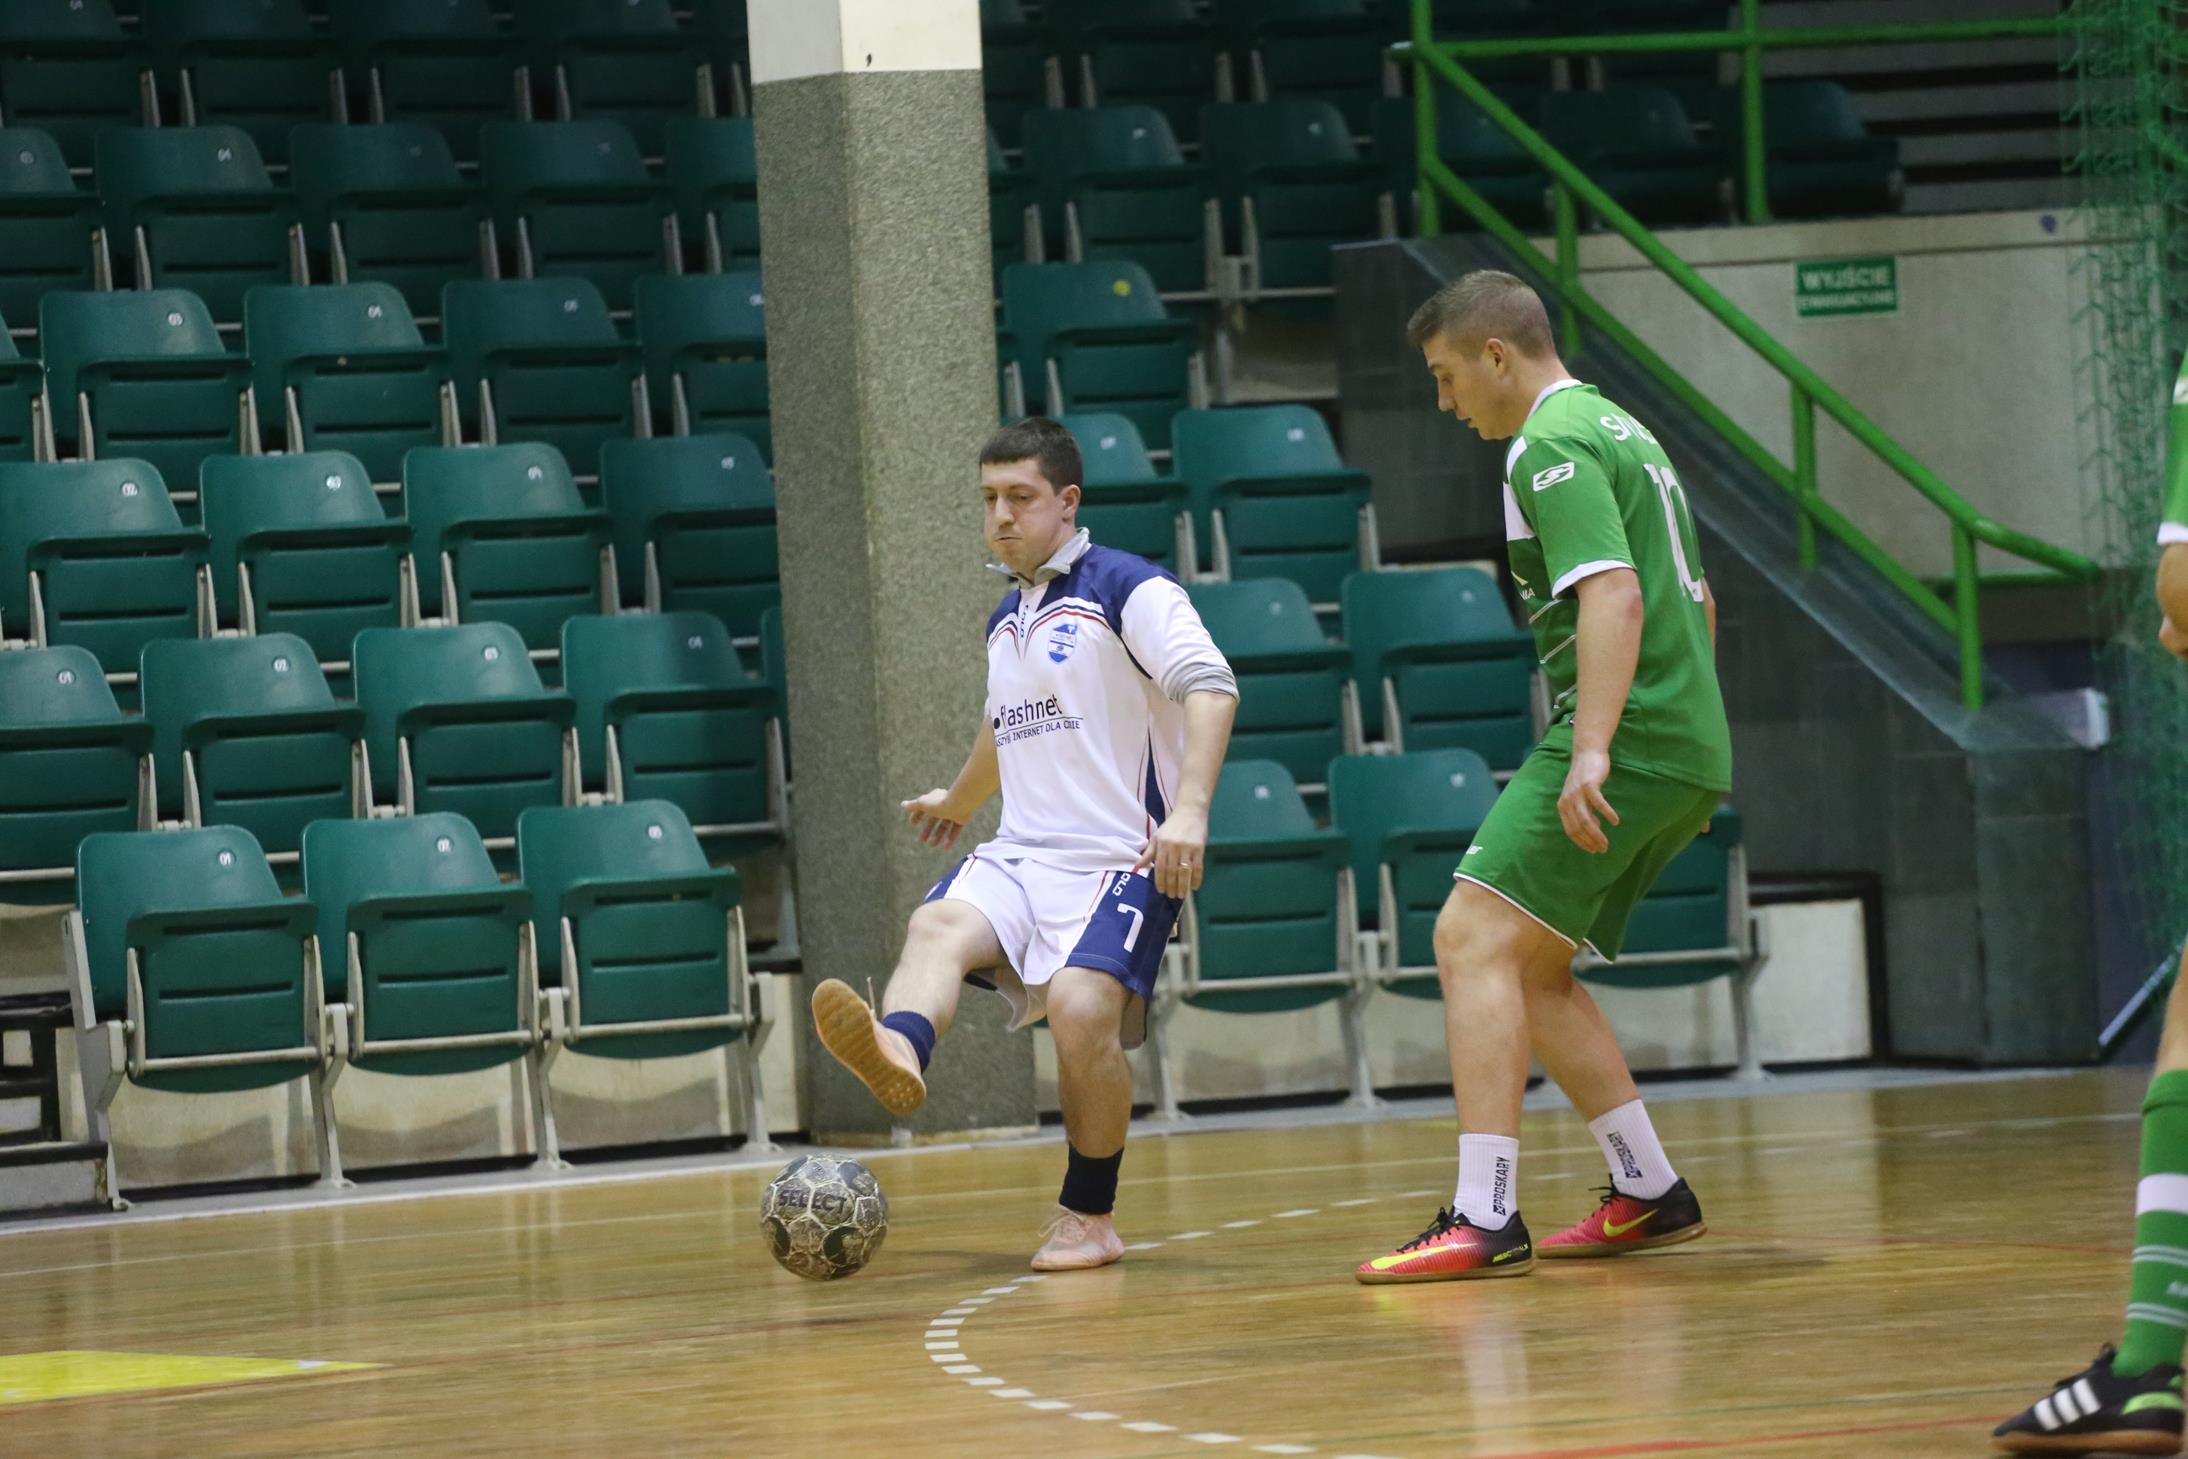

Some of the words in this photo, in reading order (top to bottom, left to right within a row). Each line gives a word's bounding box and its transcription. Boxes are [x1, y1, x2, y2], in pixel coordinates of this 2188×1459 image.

[1643, 463, 1704, 602] 10
[1013, 726, 1043, 742] INTERNET
[1045, 721, 1061, 732] DLA
[1117, 902, 1144, 953] 7
[778, 1189, 848, 1217] SELECT
[1493, 1156, 1510, 1206] PROSKARY
